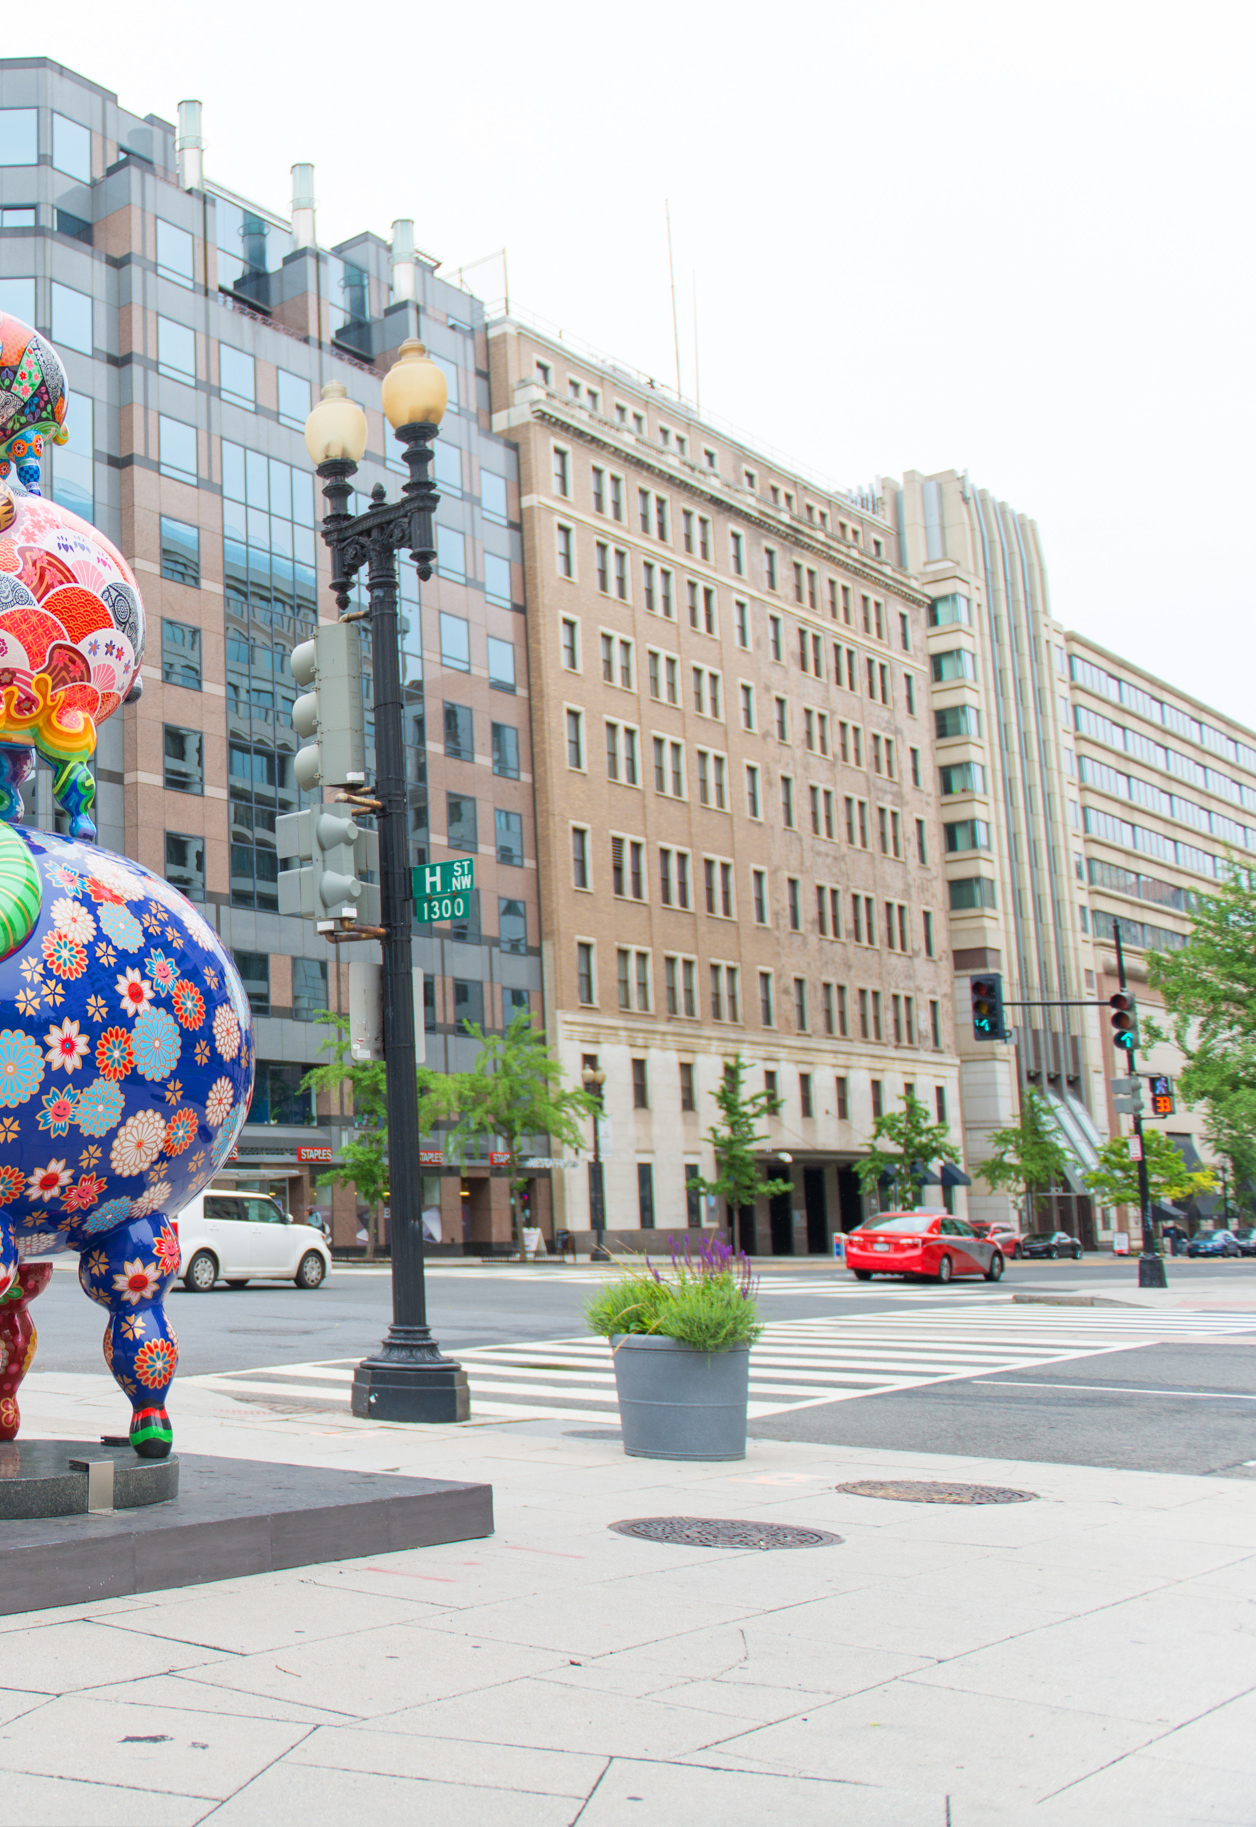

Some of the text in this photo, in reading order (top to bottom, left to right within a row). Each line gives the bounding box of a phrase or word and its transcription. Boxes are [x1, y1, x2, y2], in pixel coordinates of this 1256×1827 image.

[425, 861, 470, 893] H ST
[452, 874, 472, 890] NW
[423, 898, 464, 920] 1300
[300, 1148, 332, 1160] STAPLES
